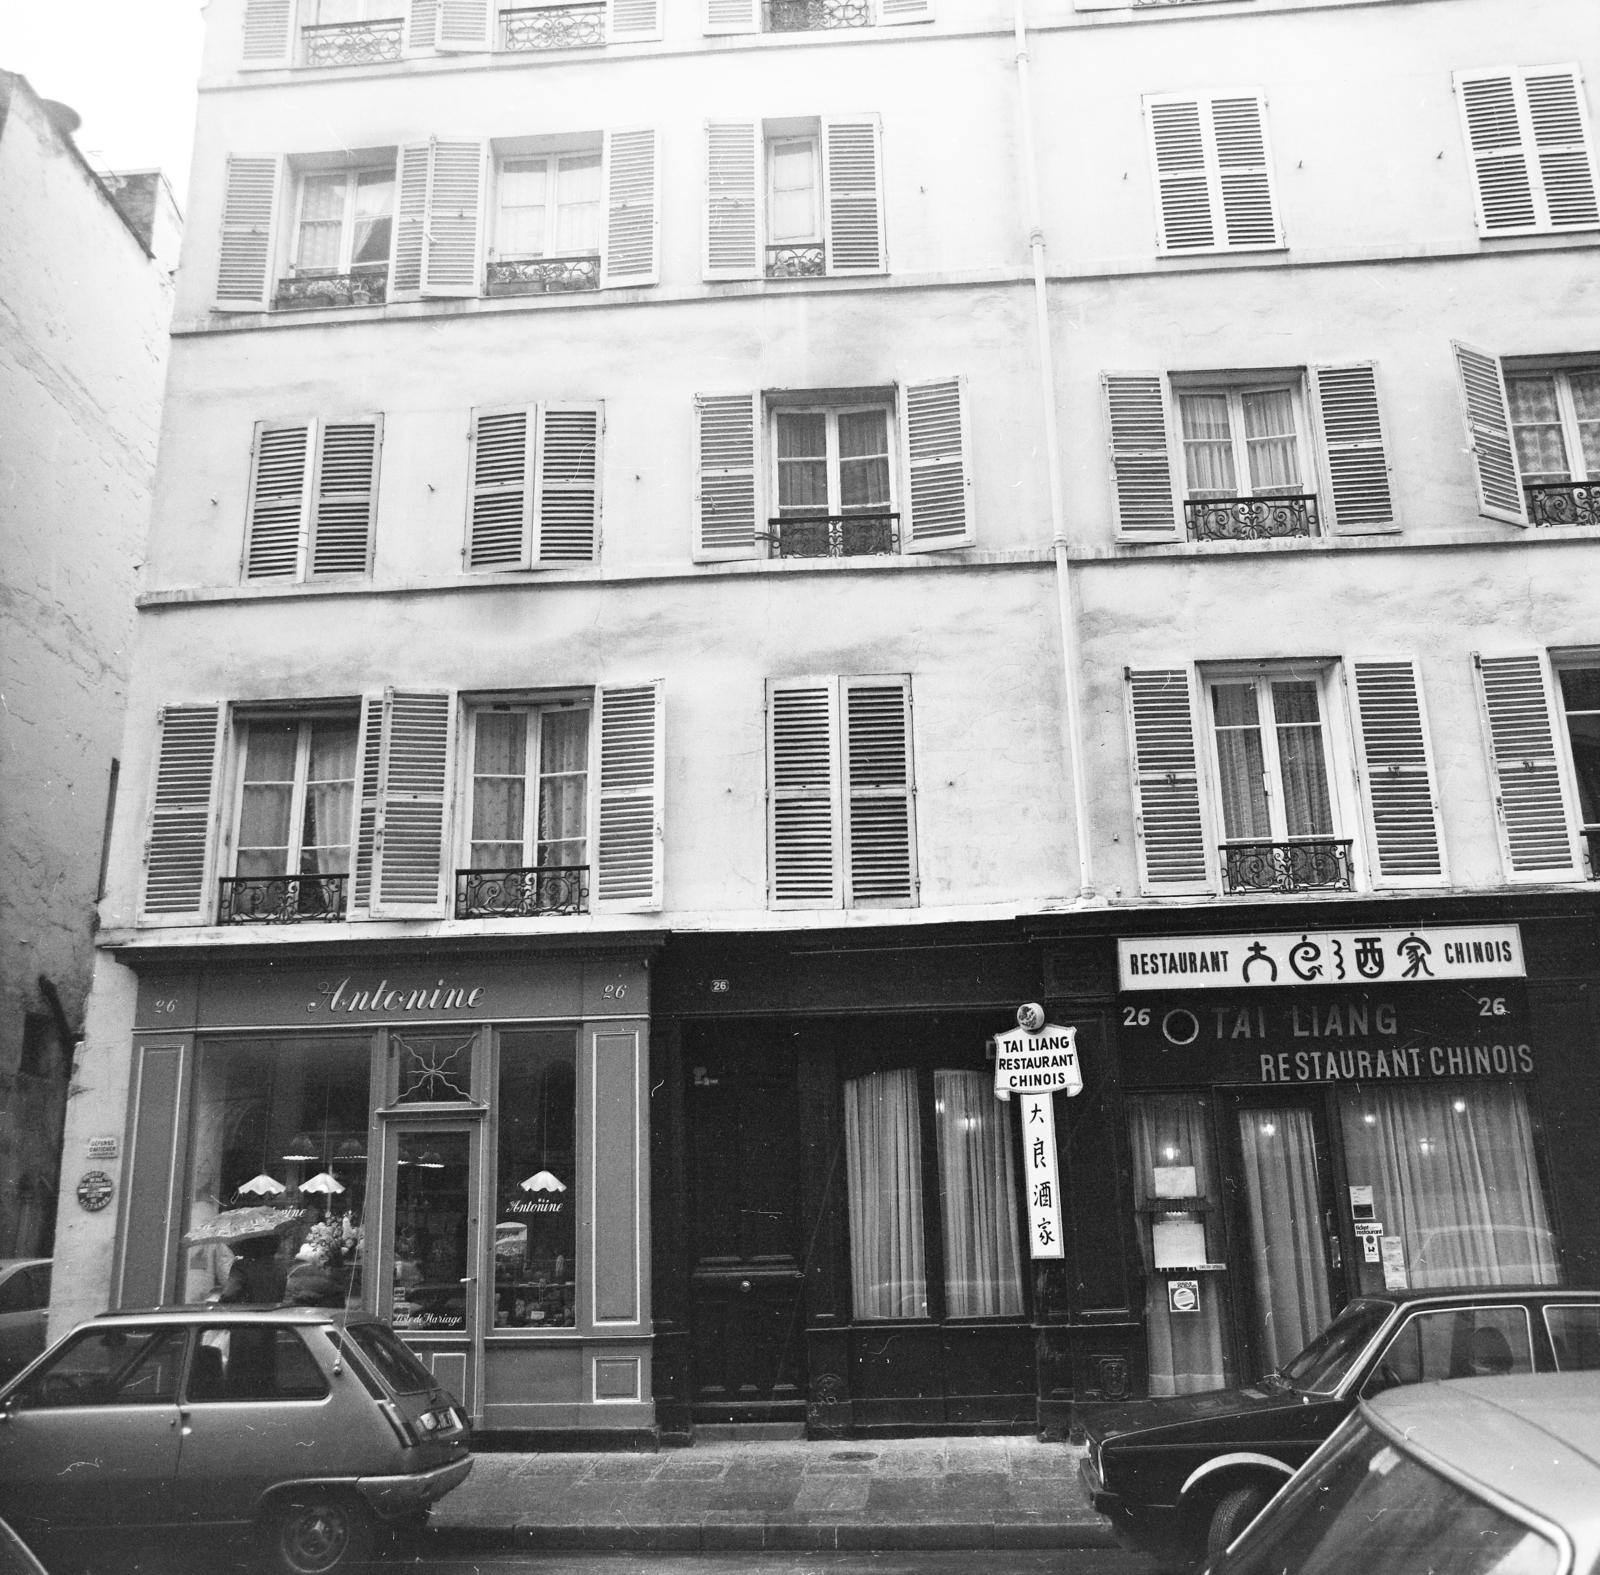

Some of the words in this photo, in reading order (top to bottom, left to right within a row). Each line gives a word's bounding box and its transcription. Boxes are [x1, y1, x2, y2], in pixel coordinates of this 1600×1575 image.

[1444, 941, 1512, 964] CHINOIS
[1130, 951, 1229, 975] RESTAURANT
[307, 976, 486, 1012] Antonine
[603, 984, 628, 999] 26
[713, 981, 727, 990] 26
[154, 999, 178, 1013] 26
[1479, 997, 1506, 1016] 26
[1123, 1007, 1150, 1026] 26
[1210, 1006, 1266, 1039] TAI
[1292, 1003, 1397, 1037] LIANG
[1003, 1040, 1024, 1053] TAI
[1029, 1036, 1070, 1051] LIANG
[998, 1054, 1074, 1070] RESTAURANT
[1260, 1048, 1420, 1082] RESTAURANT
[1429, 1045, 1534, 1075] CHINOIS
[1009, 1072, 1066, 1087] CHINOIS
[1029, 1103, 1055, 1245] 大良酒家
[506, 1199, 564, 1213] Antonine
